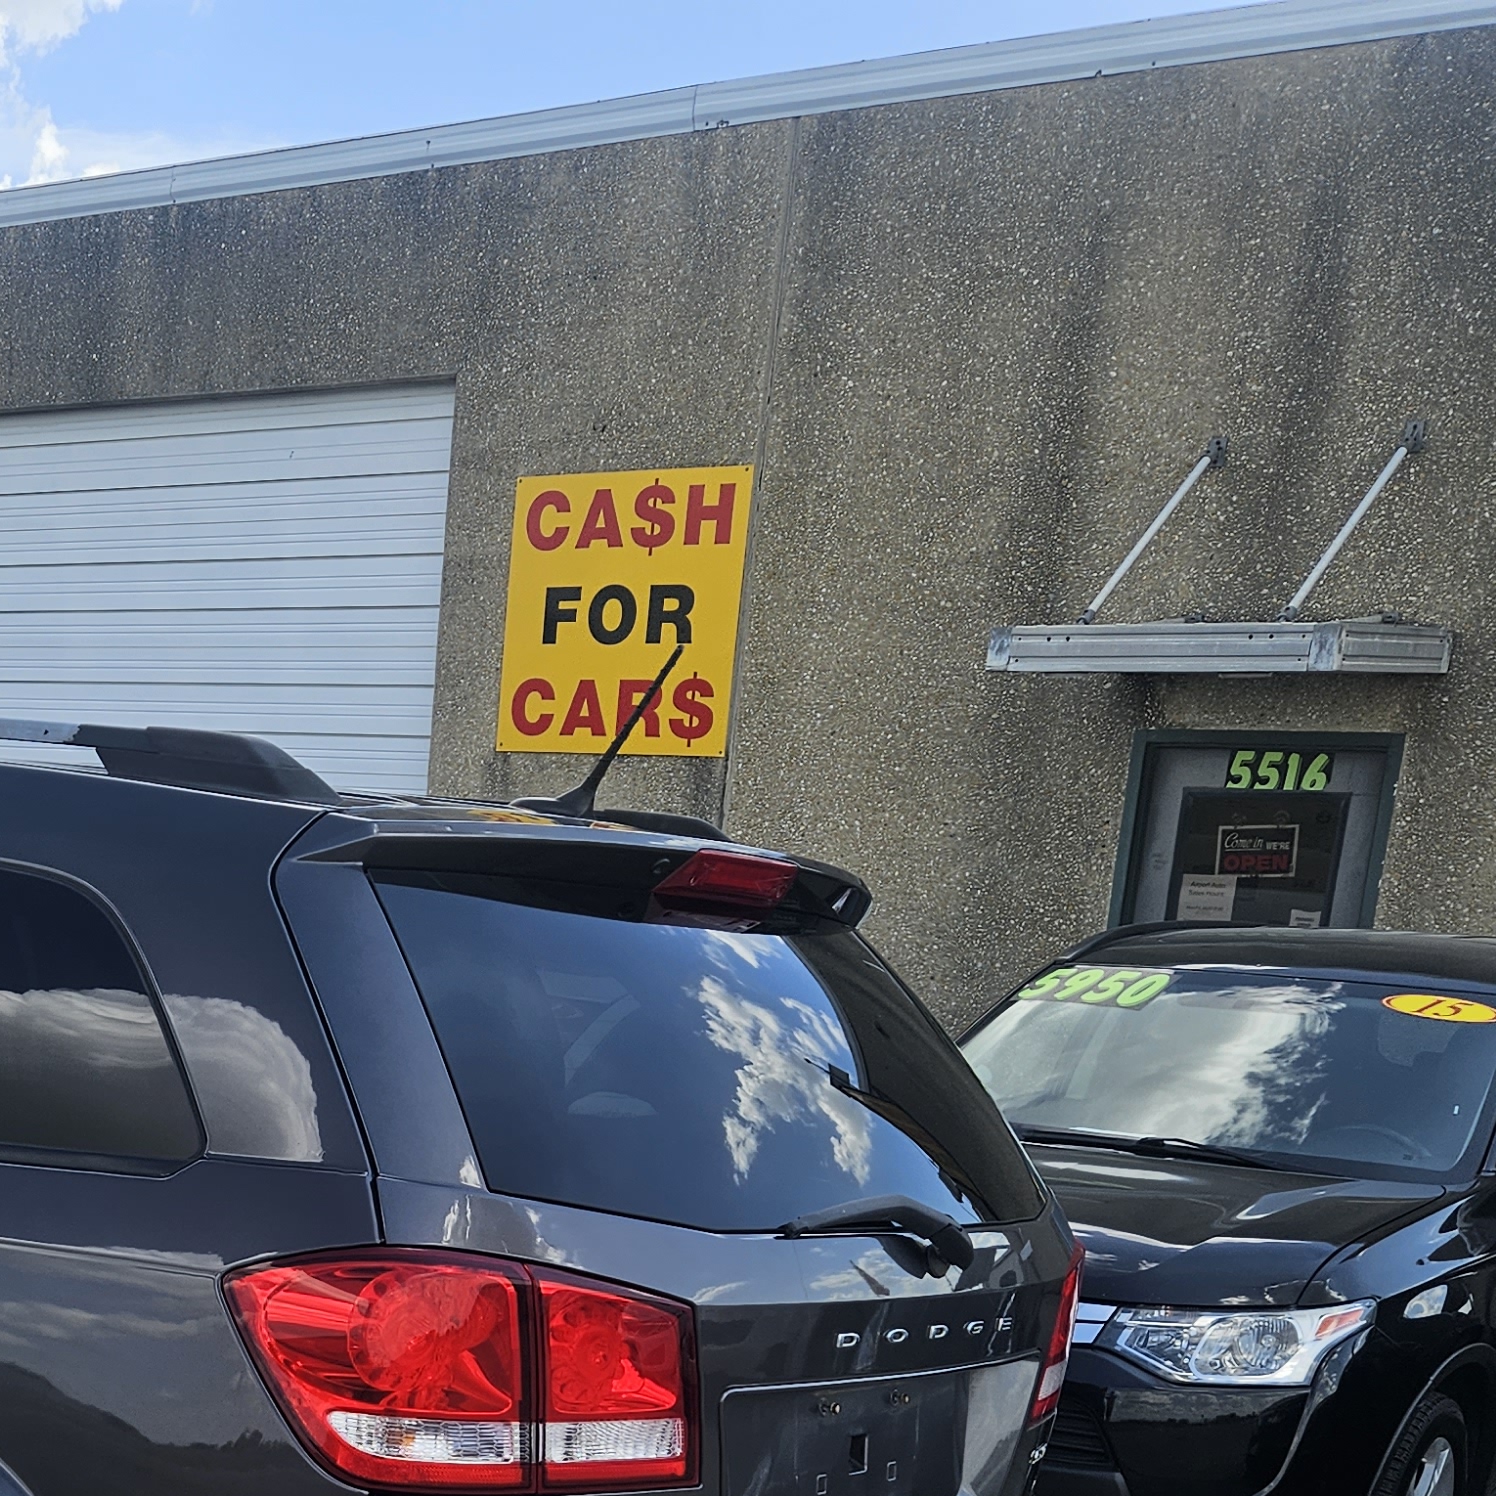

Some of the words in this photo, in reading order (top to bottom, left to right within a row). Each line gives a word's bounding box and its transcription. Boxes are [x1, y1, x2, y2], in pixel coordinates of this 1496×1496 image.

[526, 478, 737, 556] CA$H
[542, 584, 695, 646] FOR
[1226, 750, 1330, 791] 5516
[1224, 832, 1252, 849] Come
[1252, 836, 1264, 848] in
[1224, 854, 1289, 871] OPEN
[1018, 968, 1171, 1007] 5950
[1410, 999, 1474, 1017] 15
[835, 1317, 1013, 1349] DODGE
